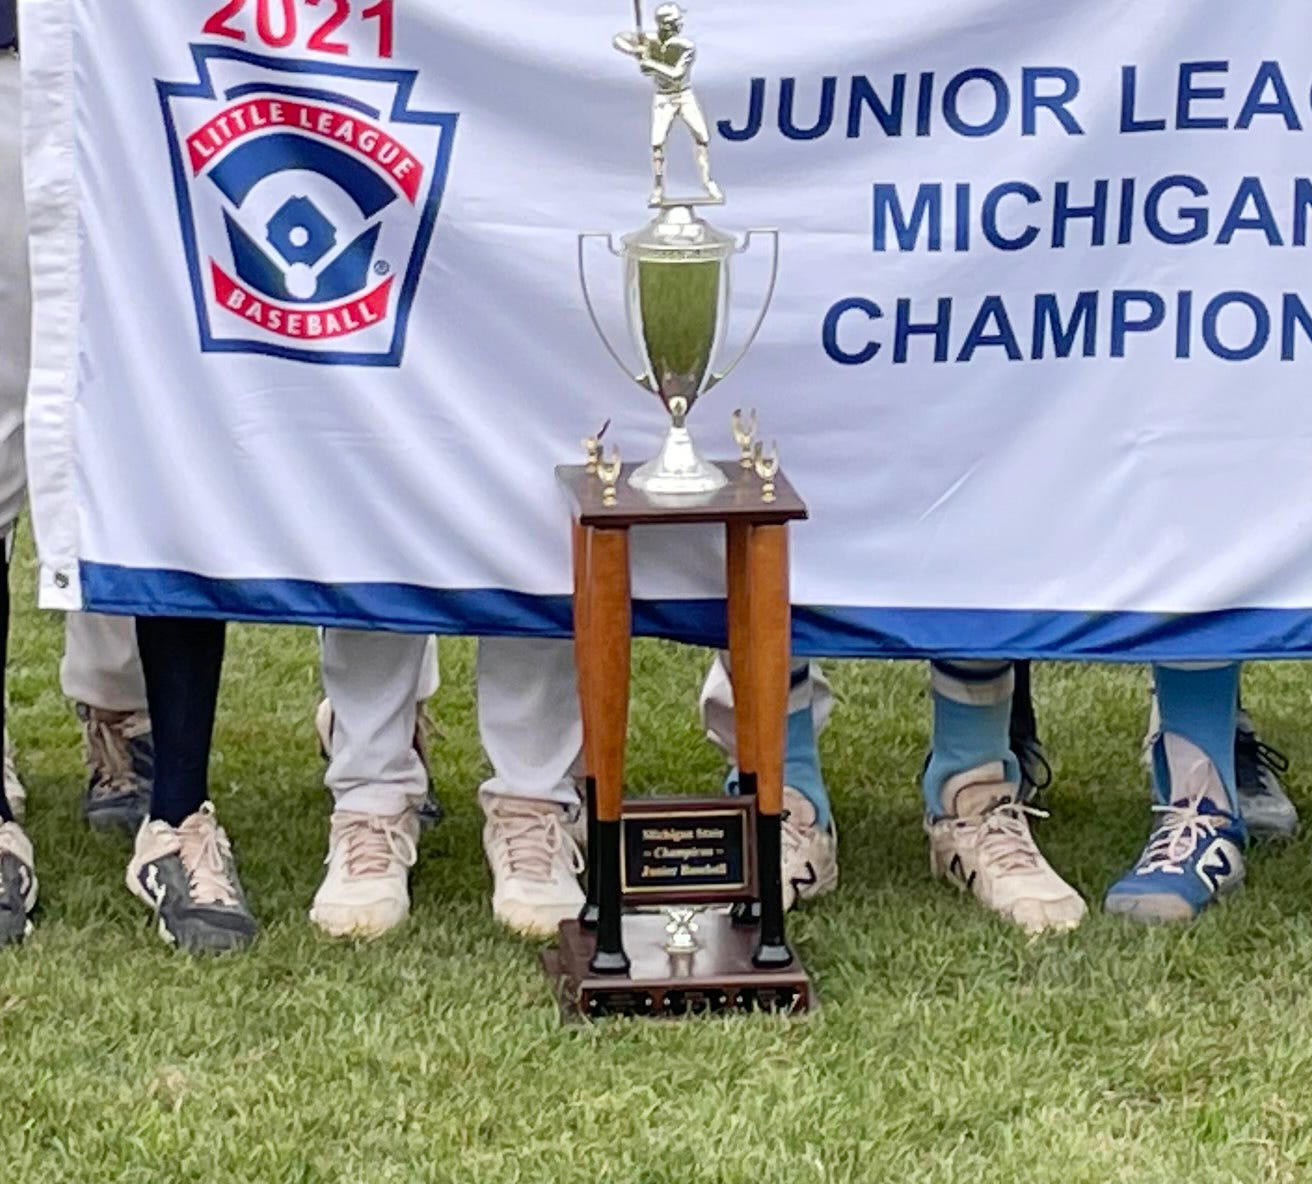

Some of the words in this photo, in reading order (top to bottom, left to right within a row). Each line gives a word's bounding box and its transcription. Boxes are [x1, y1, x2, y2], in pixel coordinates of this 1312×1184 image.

[717, 65, 1085, 141] JUNIOR
[191, 102, 286, 158] LITTLE
[299, 107, 416, 181] LEAGUE
[225, 287, 379, 336] BASEBALL
